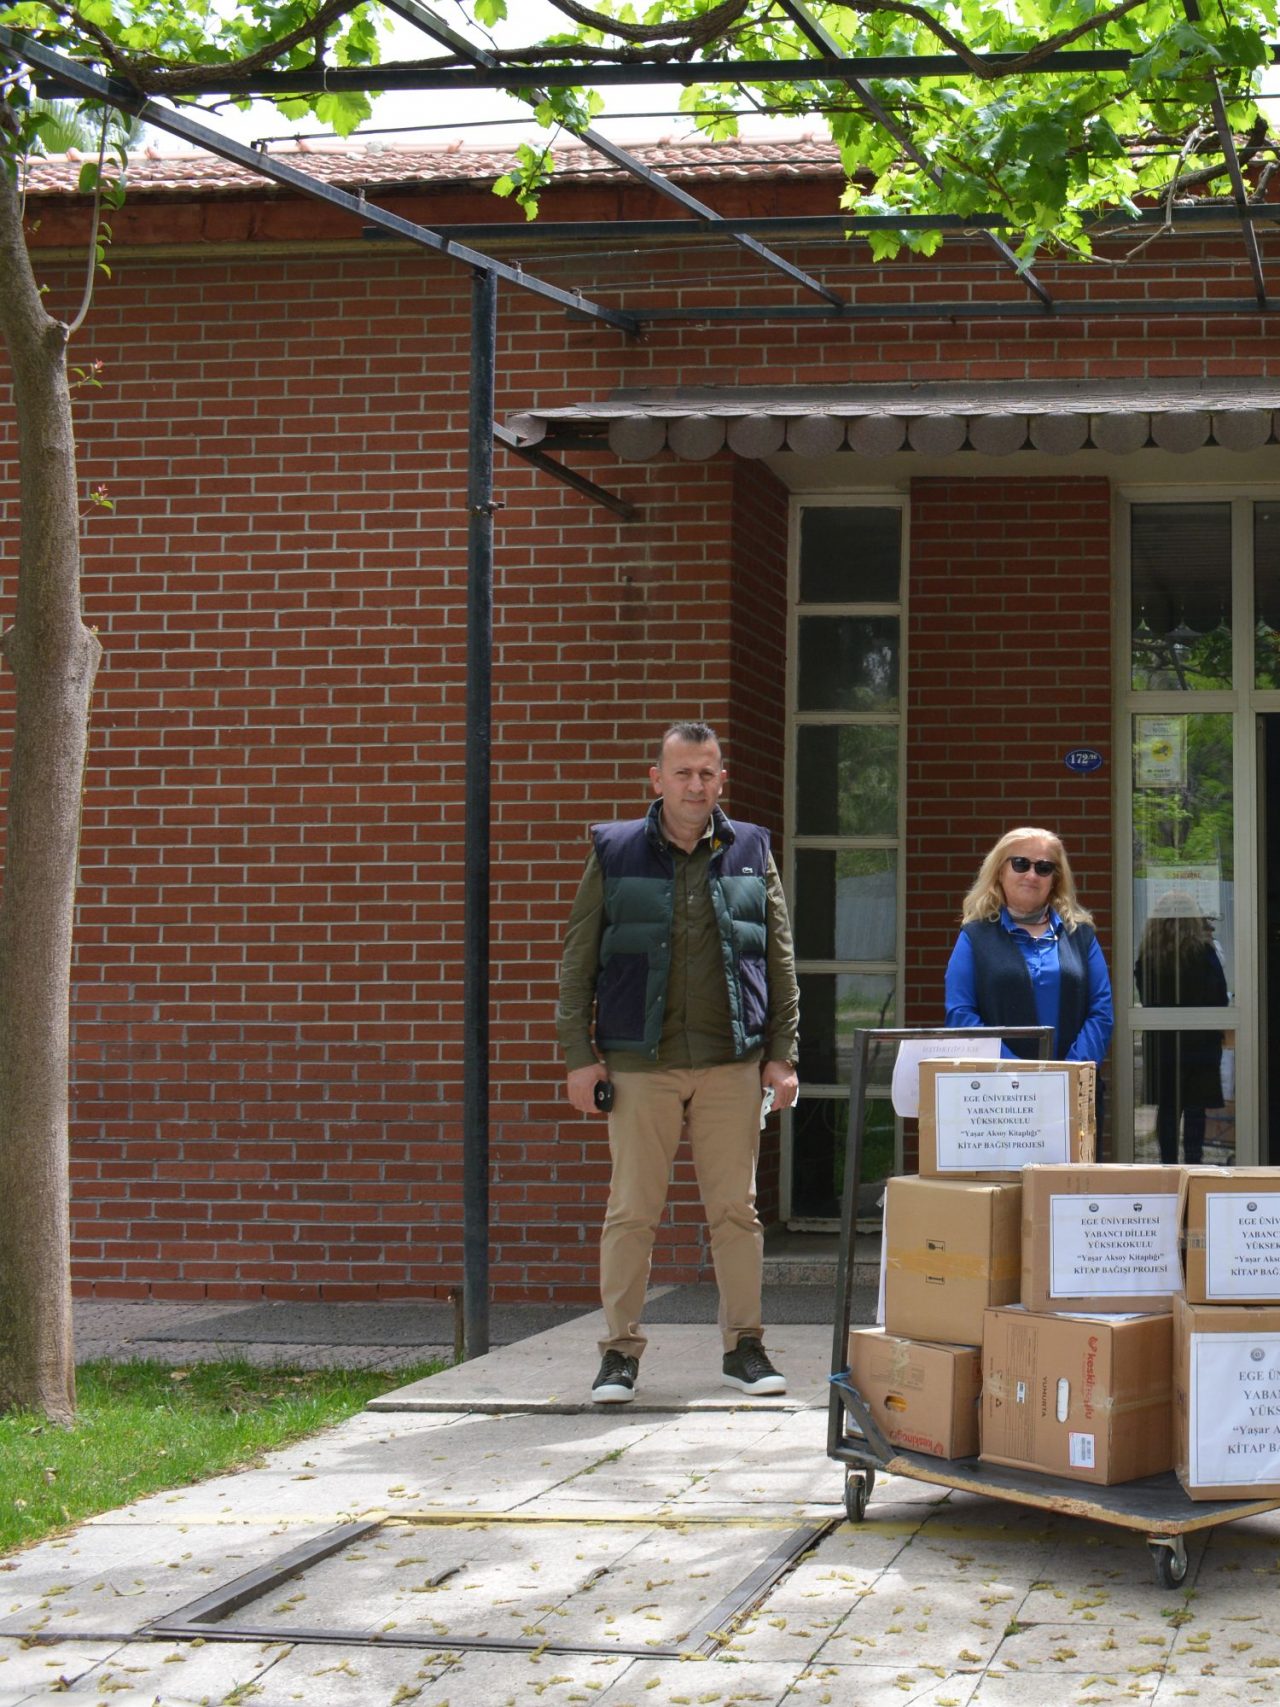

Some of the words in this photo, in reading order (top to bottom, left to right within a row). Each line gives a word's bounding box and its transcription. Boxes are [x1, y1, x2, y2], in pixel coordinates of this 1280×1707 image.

[964, 1095, 980, 1103] EGE
[982, 1092, 1037, 1102] ÜNİVERSİTESİ
[967, 1107, 1004, 1115] YABANCI
[1005, 1106, 1034, 1114] DİLLER
[970, 1116, 1030, 1125] YÜKSEKOKULU
[987, 1129, 1006, 1137] Aksoy
[957, 1140, 983, 1149] KİTAP
[1012, 1140, 1045, 1149] PROJESİ
[1081, 1218, 1098, 1226] EGE
[1101, 1216, 1160, 1225] ÜNİVERSİTESİ
[1238, 1217, 1257, 1225] EGE
[1084, 1230, 1123, 1238] YABANCI
[1125, 1229, 1157, 1237] DİLLER
[1088, 1240, 1153, 1249] YÜKSEKOKULU
[1105, 1254, 1126, 1262] Aksoy
[1074, 1266, 1100, 1275] KİTAP
[1133, 1265, 1168, 1273] PROJESİ
[1231, 1268, 1259, 1276] KİTAP
[1239, 1371, 1264, 1381] EGE
[1227, 1442, 1266, 1454] KİTAP
